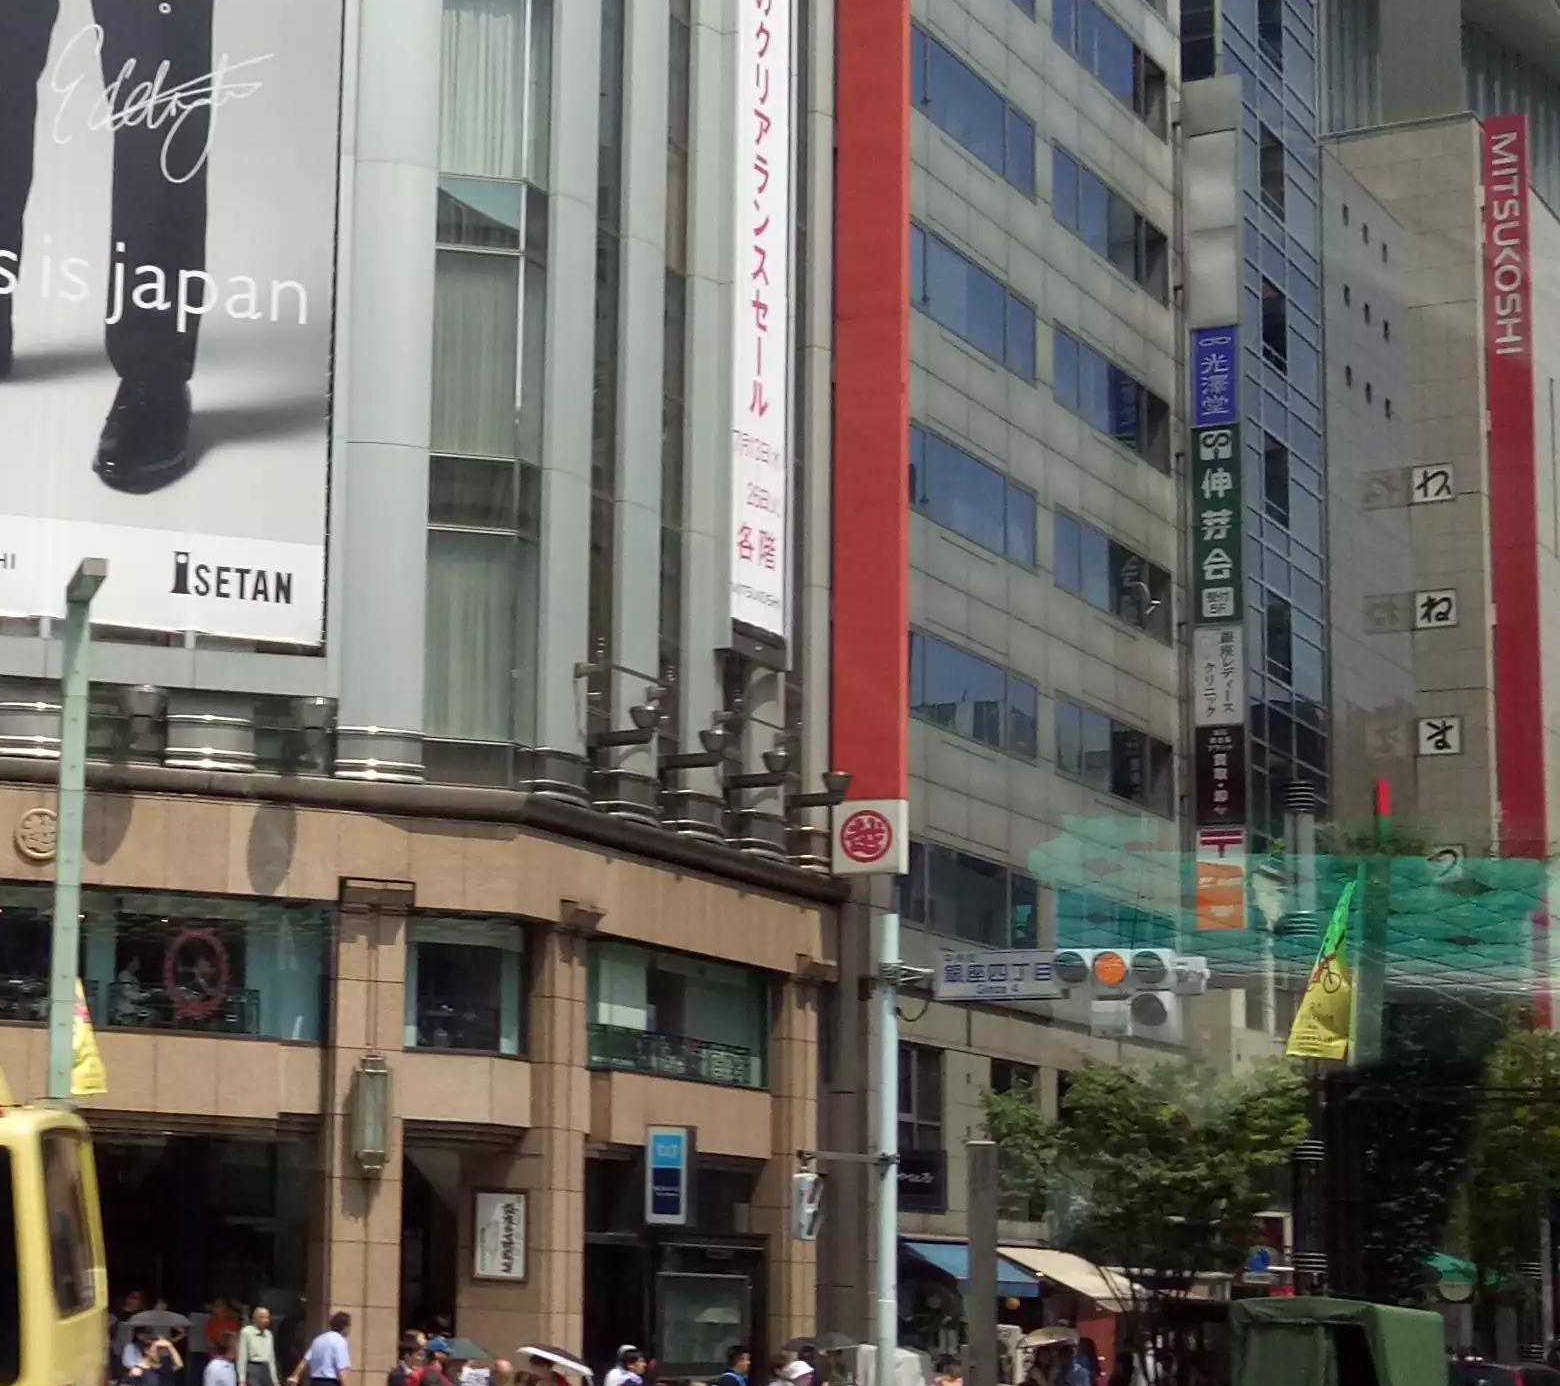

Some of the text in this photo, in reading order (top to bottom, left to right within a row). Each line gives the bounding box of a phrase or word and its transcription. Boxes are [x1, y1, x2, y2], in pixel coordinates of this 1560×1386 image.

[40, 234, 89, 302] is
[105, 242, 309, 333] japan
[1490, 131, 1524, 355] MITSUKOSHI
[943, 963, 1053, 984] 銀座四丁目
